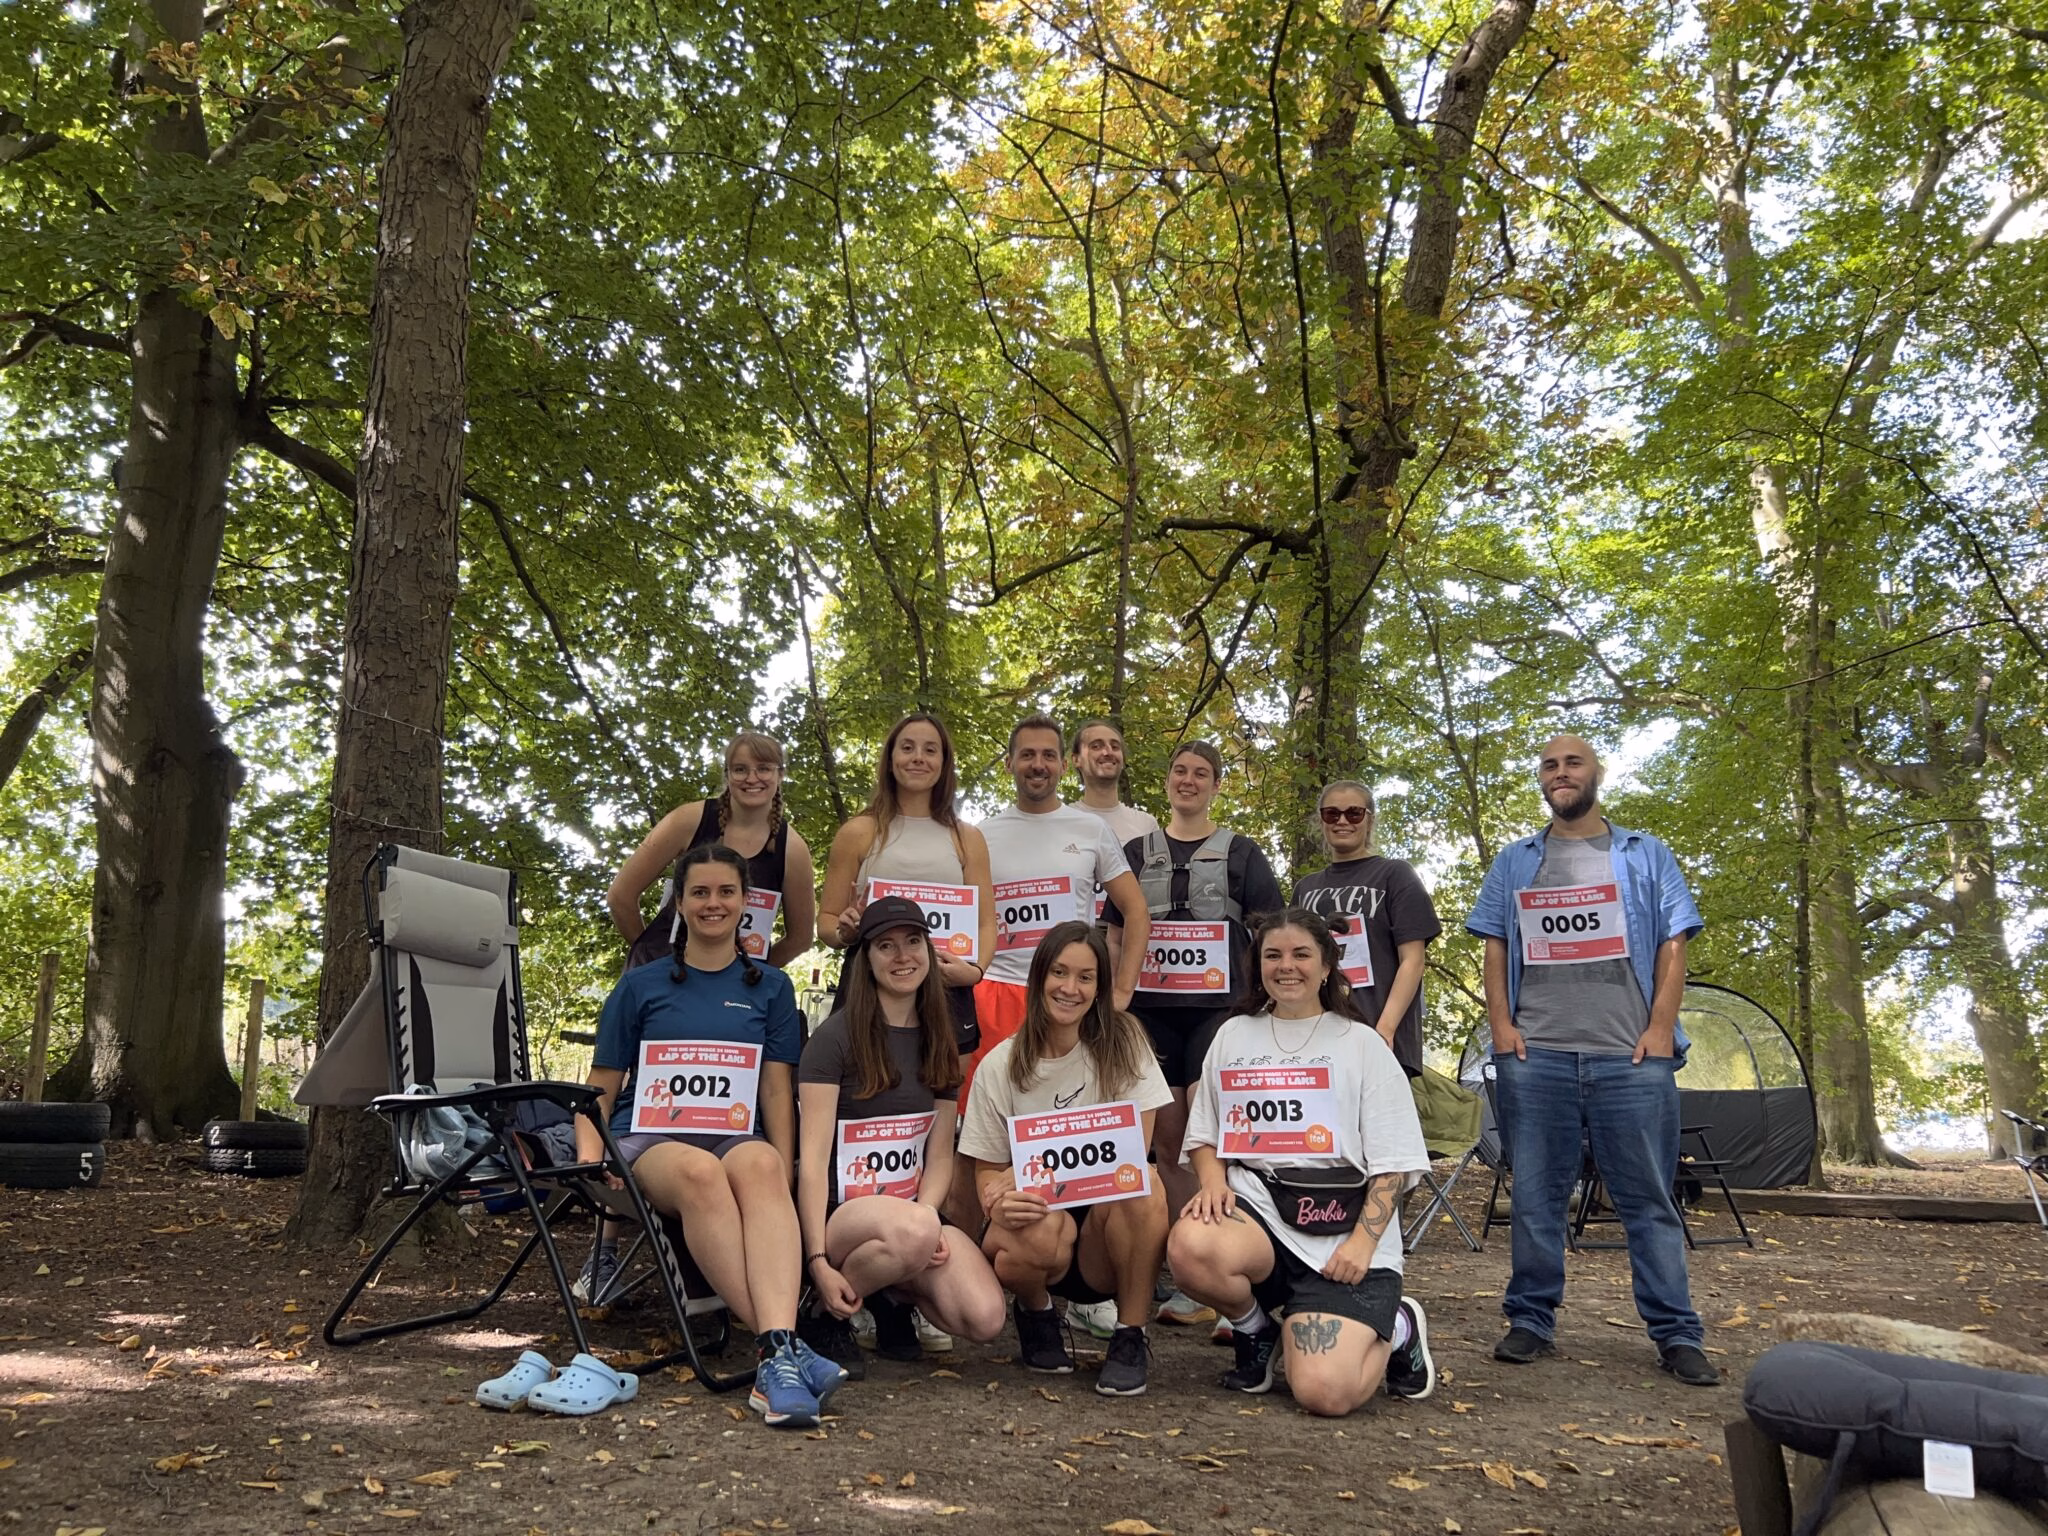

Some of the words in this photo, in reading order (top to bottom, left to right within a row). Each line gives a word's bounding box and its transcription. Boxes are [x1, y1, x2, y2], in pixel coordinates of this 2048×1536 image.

[883, 889, 902, 897] LAP
[919, 892, 937, 900] THE
[939, 893, 962, 902] LAKE
[1020, 887, 1036, 895] THE
[1038, 884, 1061, 892] LAKE
[1530, 898, 1546, 906] LAP
[1548, 897, 1559, 905] OF
[1561, 896, 1580, 904] THE
[1581, 892, 1606, 902] LAKE
[1005, 903, 1049, 924] 0011
[1541, 912, 1601, 934] 0005
[1155, 947, 1207, 966] 0003
[658, 1052, 680, 1061] LAP
[681, 1053, 696, 1061] OF
[698, 1053, 719, 1062] THE
[721, 1054, 746, 1064] LAKE
[669, 1074, 731, 1098] 0012
[1230, 1078, 1248, 1087] LAP
[1250, 1078, 1263, 1086] OF
[1265, 1077, 1286, 1086] THE
[1288, 1077, 1316, 1085] LAKE
[1246, 1099, 1304, 1122] 0013
[210, 1125, 220, 1146] 2
[856, 1130, 877, 1139] LAP
[879, 1129, 894, 1137] OF
[1028, 1125, 1050, 1136] LAP
[1052, 1123, 1067, 1132] OF
[1069, 1120, 1091, 1131] THE
[1093, 1115, 1122, 1127] LAKE
[79, 1152, 93, 1181] 5
[244, 1151, 256, 1169] 1
[867, 1144, 918, 1173] 0006
[1042, 1140, 1117, 1172] 0008
[1297, 1196, 1347, 1225] Barbie
